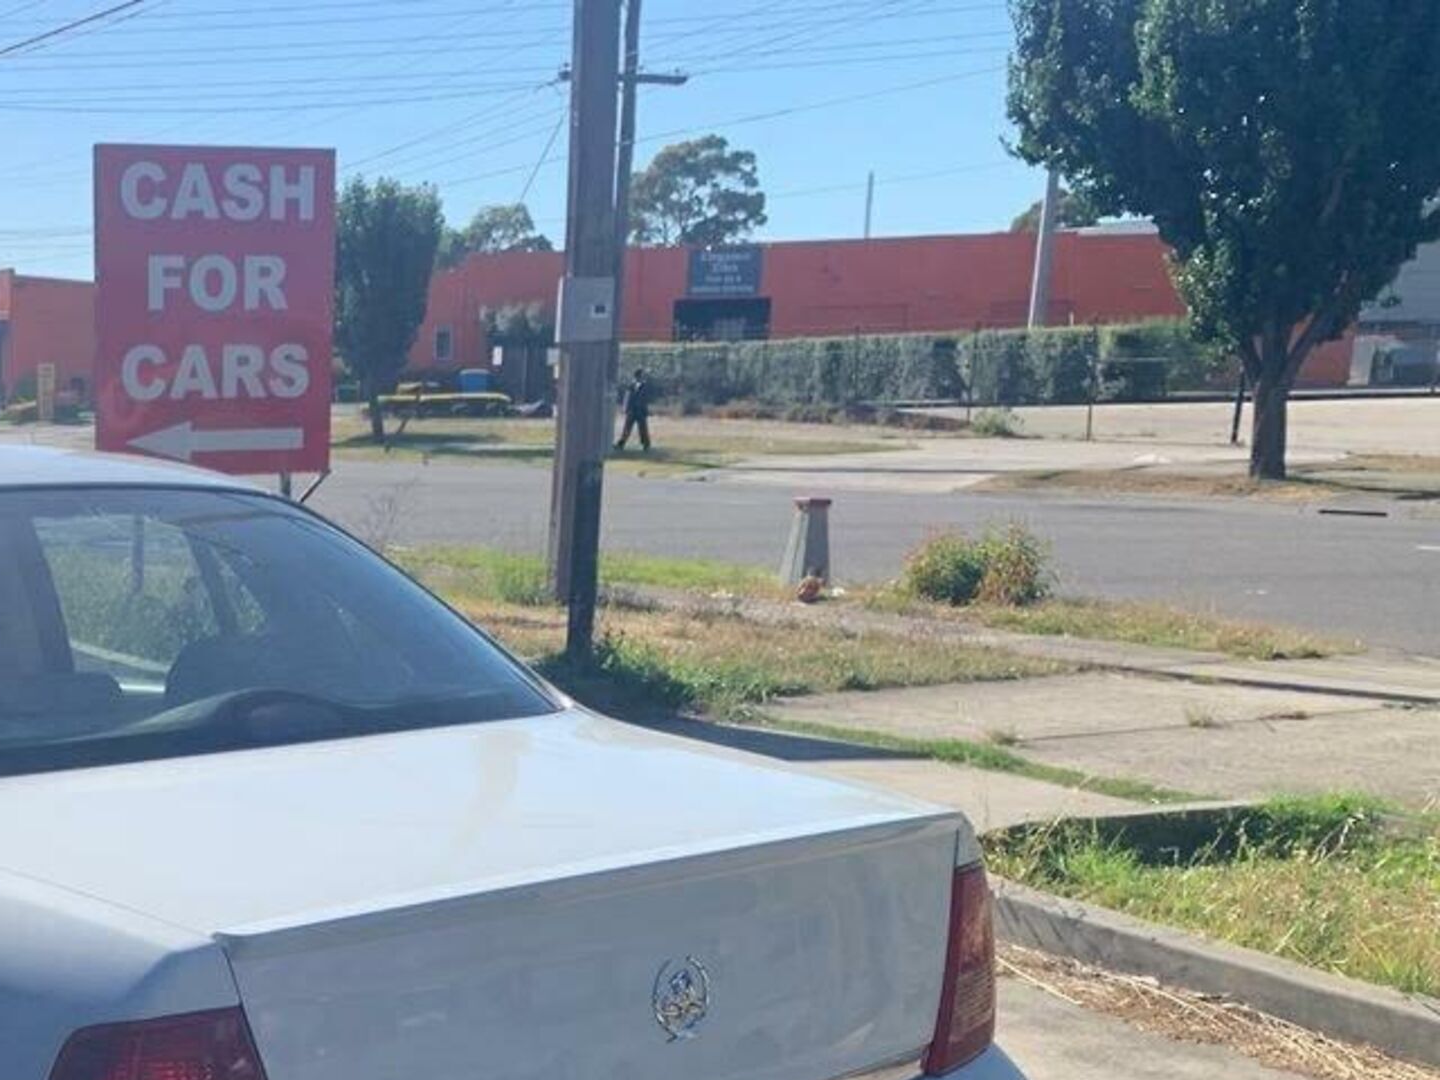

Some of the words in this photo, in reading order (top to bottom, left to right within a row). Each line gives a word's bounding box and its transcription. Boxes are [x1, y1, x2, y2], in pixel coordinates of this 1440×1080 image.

[120, 161, 315, 221] CASH
[147, 254, 288, 311] FOR
[121, 343, 309, 400] CARS
